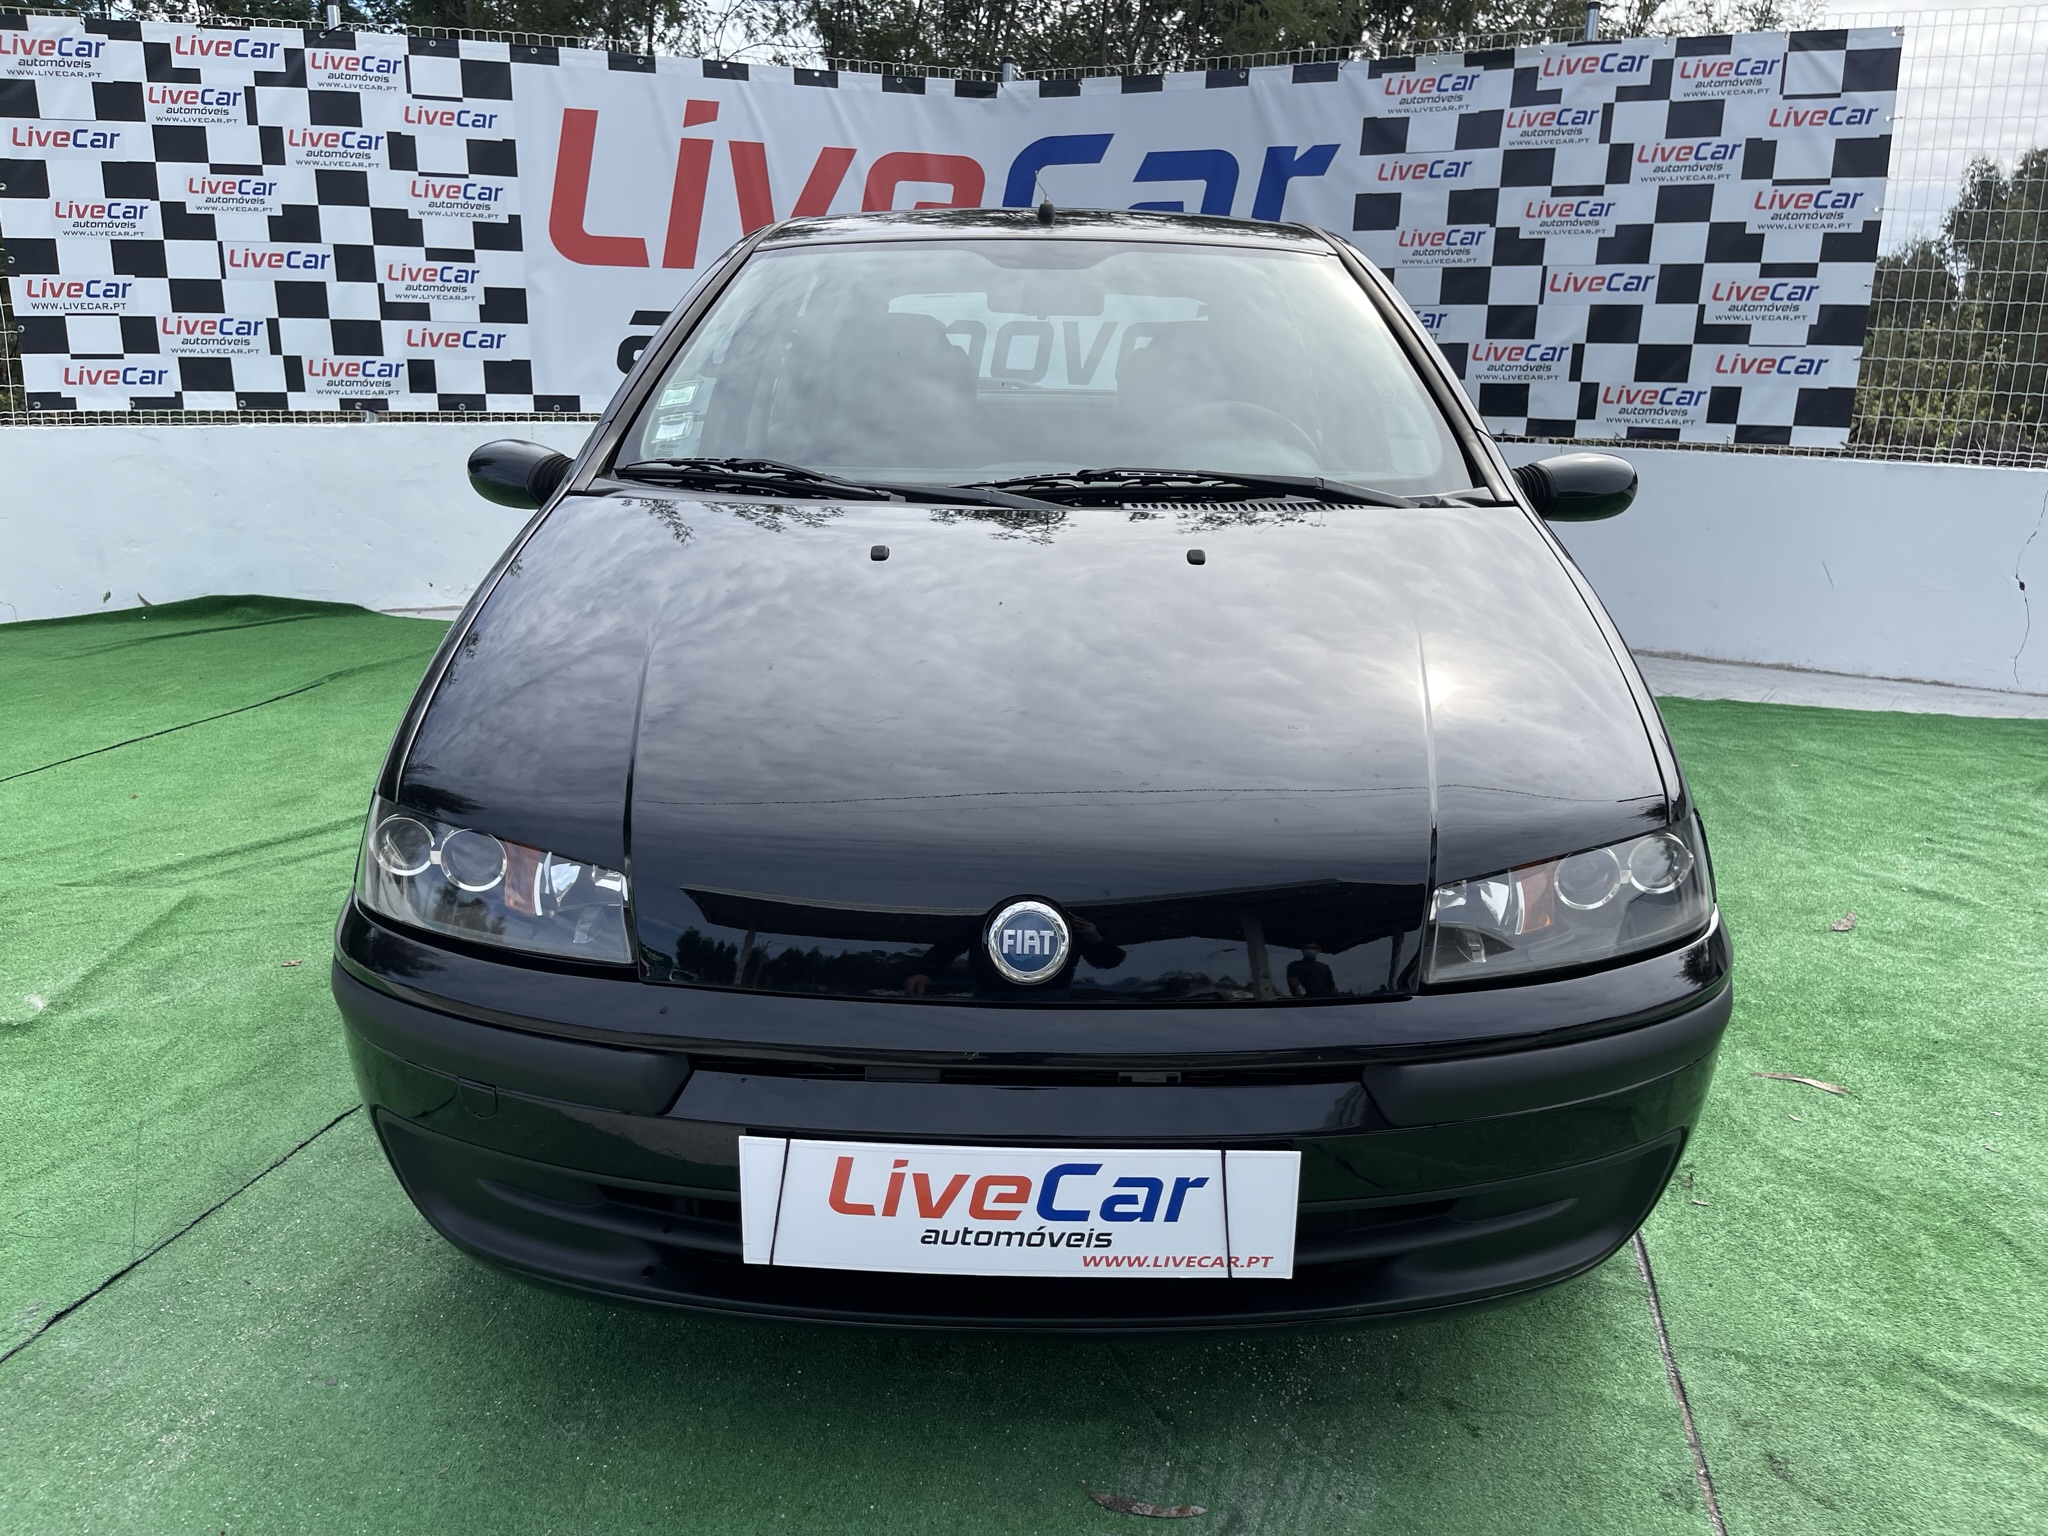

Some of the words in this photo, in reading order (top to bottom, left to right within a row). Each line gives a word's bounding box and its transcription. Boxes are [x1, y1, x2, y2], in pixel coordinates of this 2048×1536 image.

[0, 35, 105, 58] LiveCar
[175, 35, 280, 59] LiveCar
[18, 58, 91, 68] automóveis
[311, 52, 402, 74] LiveCar
[1542, 53, 1649, 77] LiveCar
[1680, 58, 1780, 79] LiveCar
[6, 69, 102, 78] WWW.LIVECAR.PT
[328, 72, 389, 83] automóveis
[1695, 77, 1762, 88] automóveis
[318, 82, 398, 92] WWW.LIVECAR.PT
[1385, 73, 1480, 95] LiveCar
[1683, 88, 1770, 97] WWW.LIVECAR.PT
[148, 86, 241, 106] LiveCar
[1399, 94, 1463, 105] automóveis
[166, 106, 229, 116] automóveis
[404, 106, 498, 128] LiveCar
[1388, 104, 1470, 114] WWW.LIVECAR.PT
[1506, 108, 1599, 128] LiveCar
[1769, 106, 1879, 127] LiveCar
[156, 116, 238, 124] WWW.LIVECAR.PT
[12, 126, 120, 149] LiveCar
[288, 128, 384, 150] LiveCar
[1520, 127, 1583, 137] automóveis
[1509, 138, 1590, 146] WWW.LIVECAR.PT
[306, 149, 371, 160] automóveis
[1637, 142, 1742, 163] LiveCar
[295, 160, 380, 168] WWW.LIVECAR.PT
[1378, 160, 1472, 181] LiveCar
[1653, 162, 1723, 173] automóveis
[188, 177, 277, 196] LiveCar
[1640, 174, 1731, 182] WWW.LIVECAR.PT
[411, 180, 503, 202] LiveCar
[1754, 190, 1864, 210] LiveCar
[196, 205, 274, 213] WWW.LIVECAR.PT
[205, 196, 265, 205] automóveis
[428, 201, 491, 211] automóveis
[1526, 200, 1615, 218] LiveCar
[55, 201, 148, 220] LiveCar
[418, 210, 499, 219] WWW.LIVECAR.PT
[1771, 211, 1844, 221] automóveis
[72, 220, 136, 229] automóveis
[1539, 218, 1599, 227] automóveis
[1757, 222, 1852, 230] WWW.LIVECAR.PT
[1398, 229, 1486, 247] LiveCar
[229, 248, 331, 270] LiveCar
[1412, 247, 1470, 256] automóveis
[387, 263, 480, 284] LiveCar
[1549, 272, 1655, 292] LiveCar
[26, 278, 132, 299] LiveCar
[405, 284, 467, 293] automóveis
[1712, 281, 1819, 301] LiveCar
[1728, 303, 1799, 312] automóveis
[162, 316, 264, 336] LiveCar
[182, 337, 250, 346] automóveis
[407, 328, 507, 349] LiveCar
[1472, 343, 1569, 362] LiveCar
[308, 358, 405, 378] LiveCar
[1487, 363, 1552, 372] automóveis
[1716, 354, 1829, 375] LiveCar
[64, 366, 168, 385] LiveCar
[327, 379, 391, 388] automóveis
[1602, 385, 1707, 406] LiveCar
[1618, 407, 1688, 416] automóveis
[1606, 417, 1696, 425] WWW.LIVECAR.PT
[1003, 929, 1054, 955] FIAT
[828, 1155, 1209, 1223] LiveCar
[920, 1226, 1113, 1249] automóveis
[1082, 1255, 1274, 1269] WWW.LIVECAR.PT
